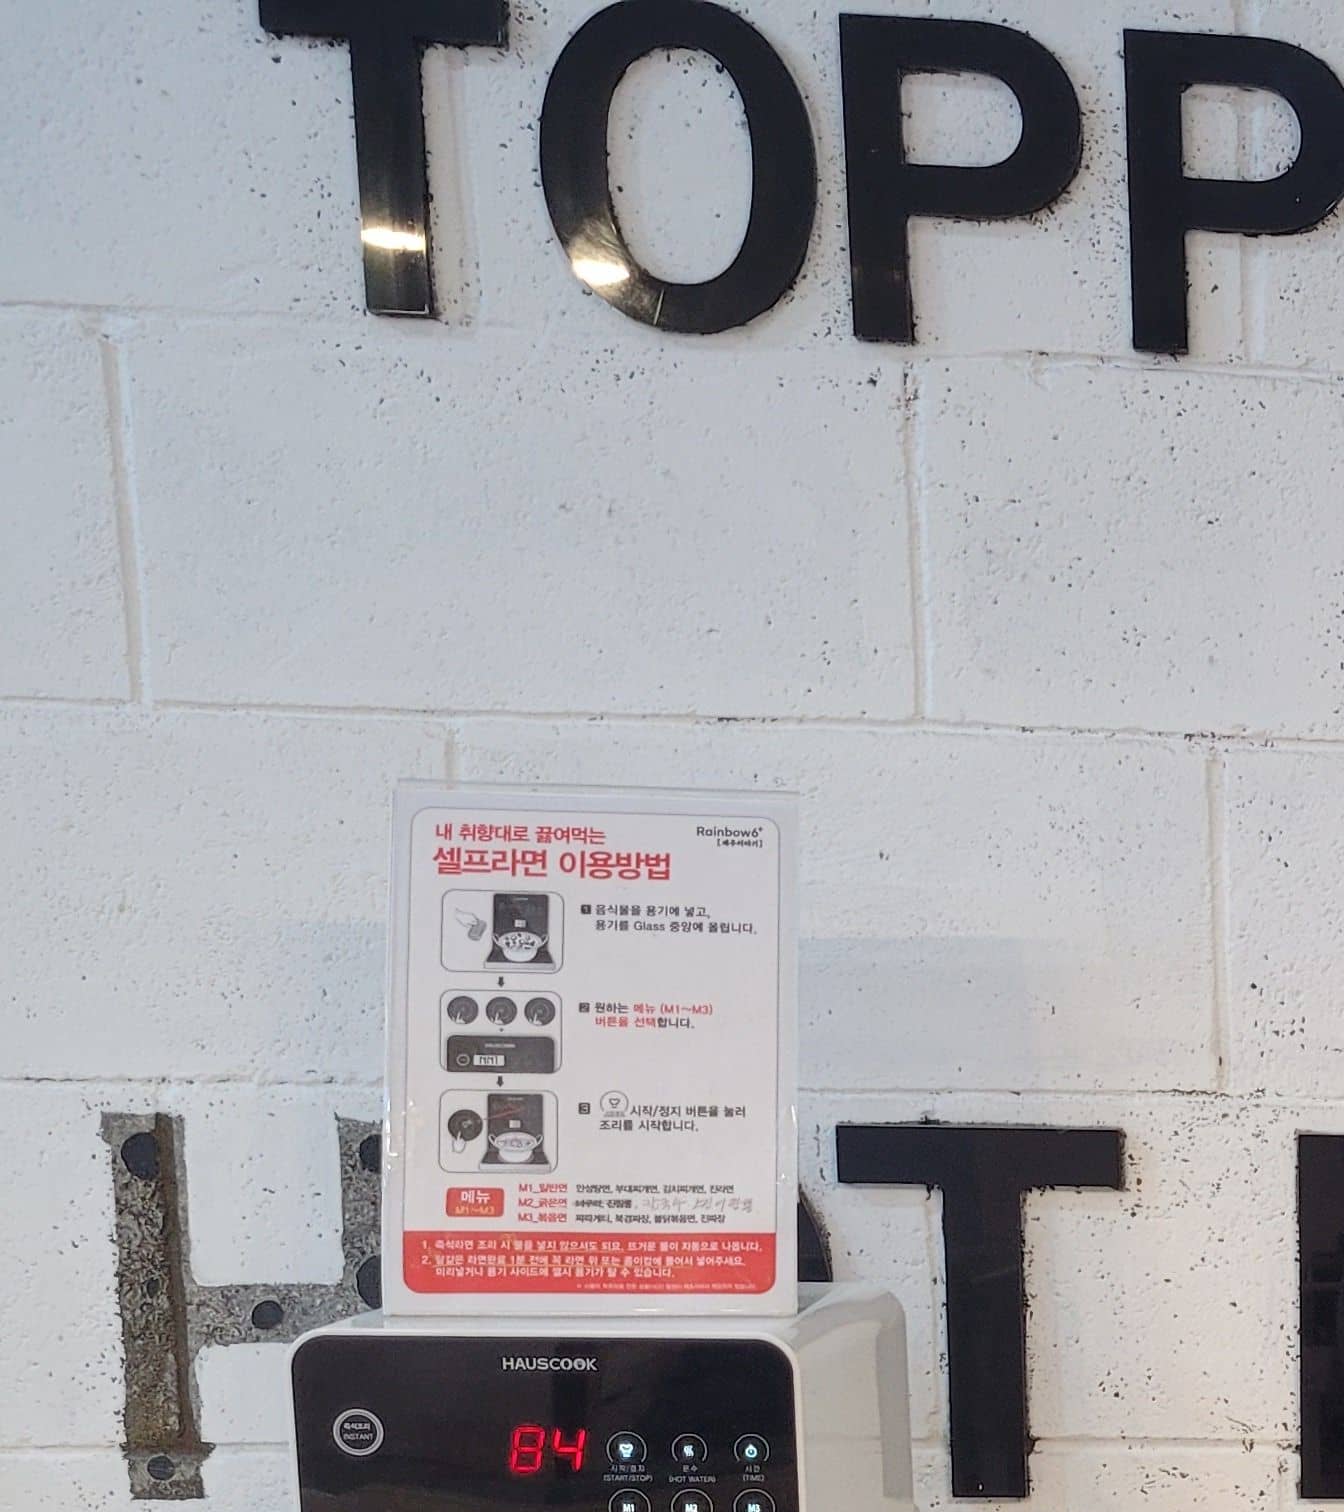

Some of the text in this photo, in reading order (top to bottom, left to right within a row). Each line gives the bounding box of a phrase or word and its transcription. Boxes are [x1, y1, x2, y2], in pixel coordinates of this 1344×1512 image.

[436, 824, 606, 845] 내 취향대로 끓여먹는
[433, 848, 672, 880] 셀프라면 이용방법
[595, 904, 679, 916] 음식물을 용기에
[595, 920, 703, 932] 용기를 Glass 중앙에
[633, 1003, 655, 1014] 메뉴
[461, 1190, 490, 1203] 메뉴
[502, 1356, 598, 1371] HAUSCOOK
[509, 1425, 587, 1474] 84
[623, 1504, 760, 1512] M1 M2 M3
